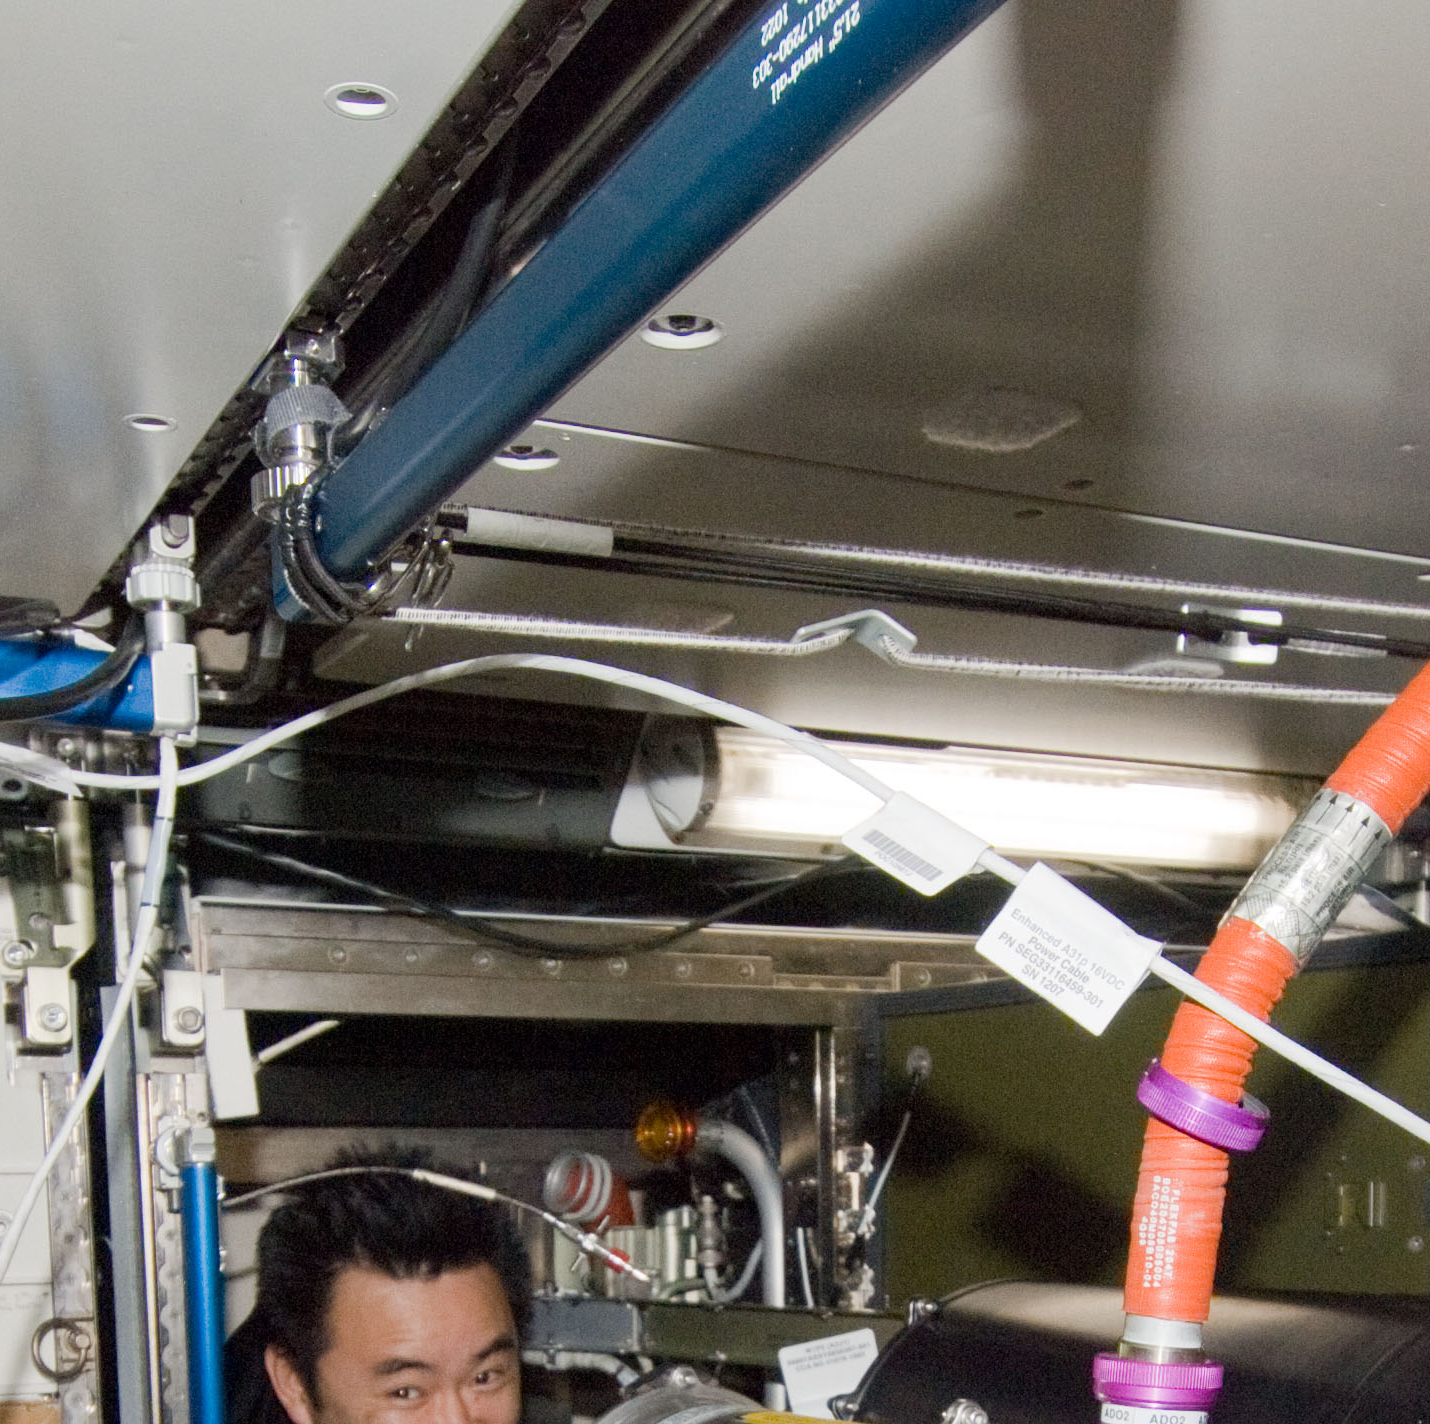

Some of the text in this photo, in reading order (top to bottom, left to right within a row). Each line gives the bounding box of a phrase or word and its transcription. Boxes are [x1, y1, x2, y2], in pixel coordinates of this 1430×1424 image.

[761, 2, 788, 47] 1022
[771, 35, 824, 105] Handrail
[997, 931, 1104, 1009] PN SEG33116459-301
[1011, 908, 1126, 992] Enhanced A31p 16VDC
[1027, 936, 1090, 983] Power Cable
[1021, 963, 1066, 998] SN 1207
